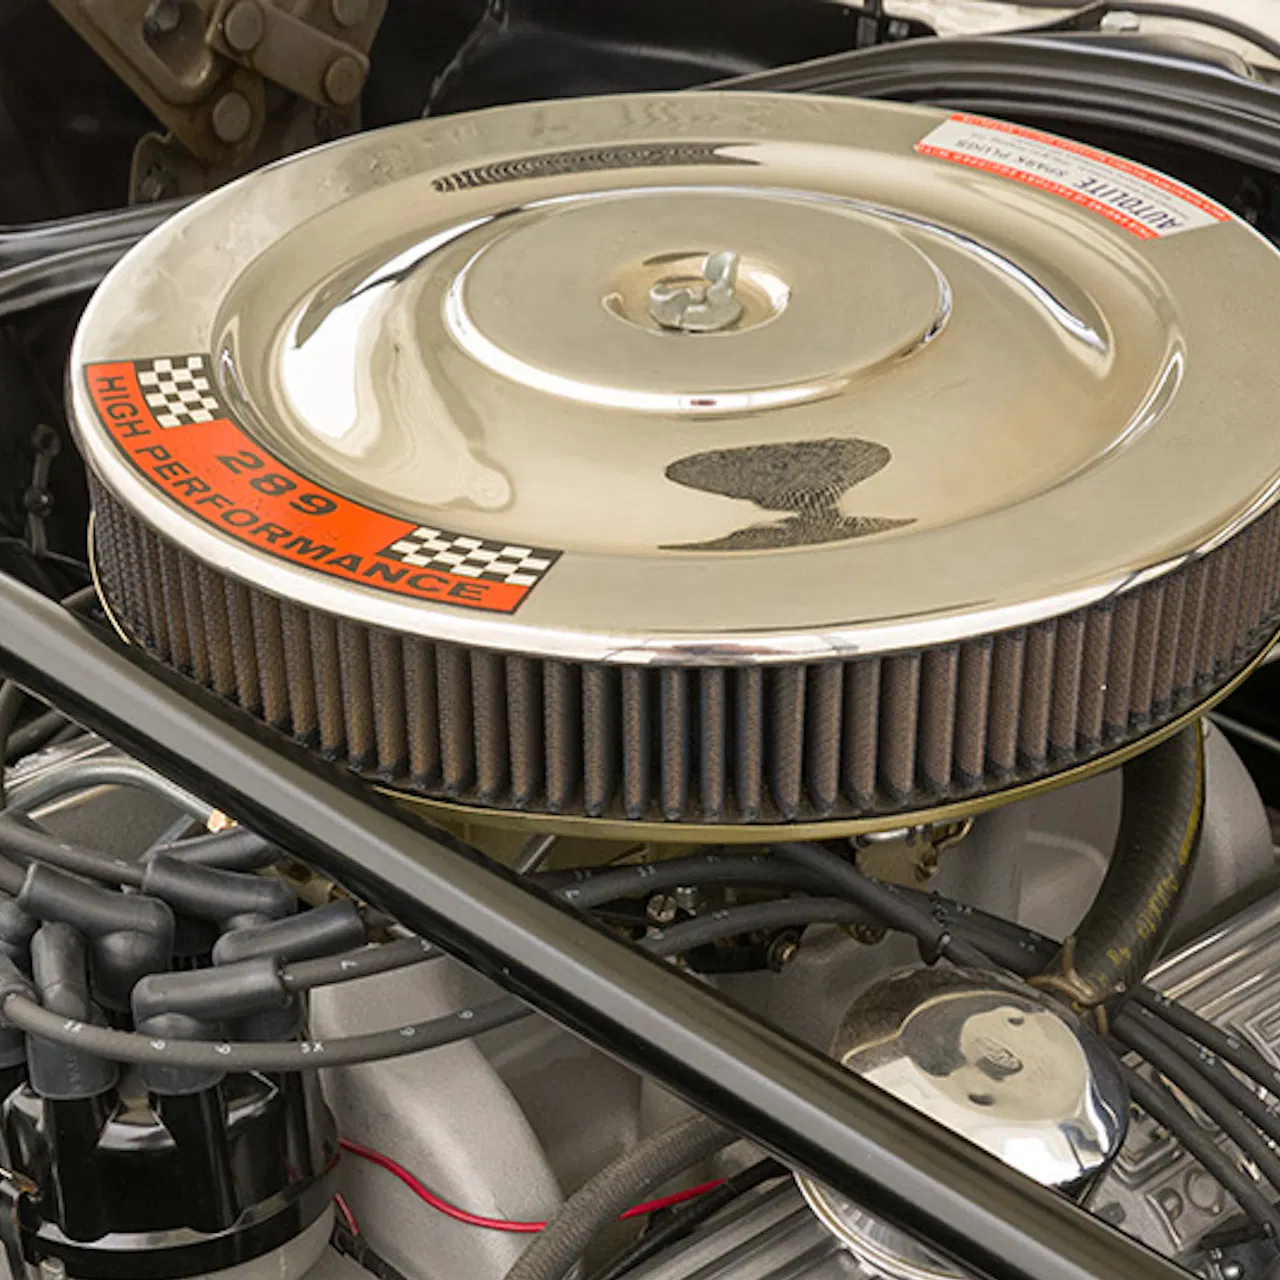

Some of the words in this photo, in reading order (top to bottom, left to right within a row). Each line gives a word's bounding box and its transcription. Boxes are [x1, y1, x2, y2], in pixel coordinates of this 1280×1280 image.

[1073, 177, 1186, 230] AUTOLITE
[95, 374, 151, 439] HIGH
[135, 444, 492, 602] PERFORMANCE
[216, 449, 339, 517] 289
